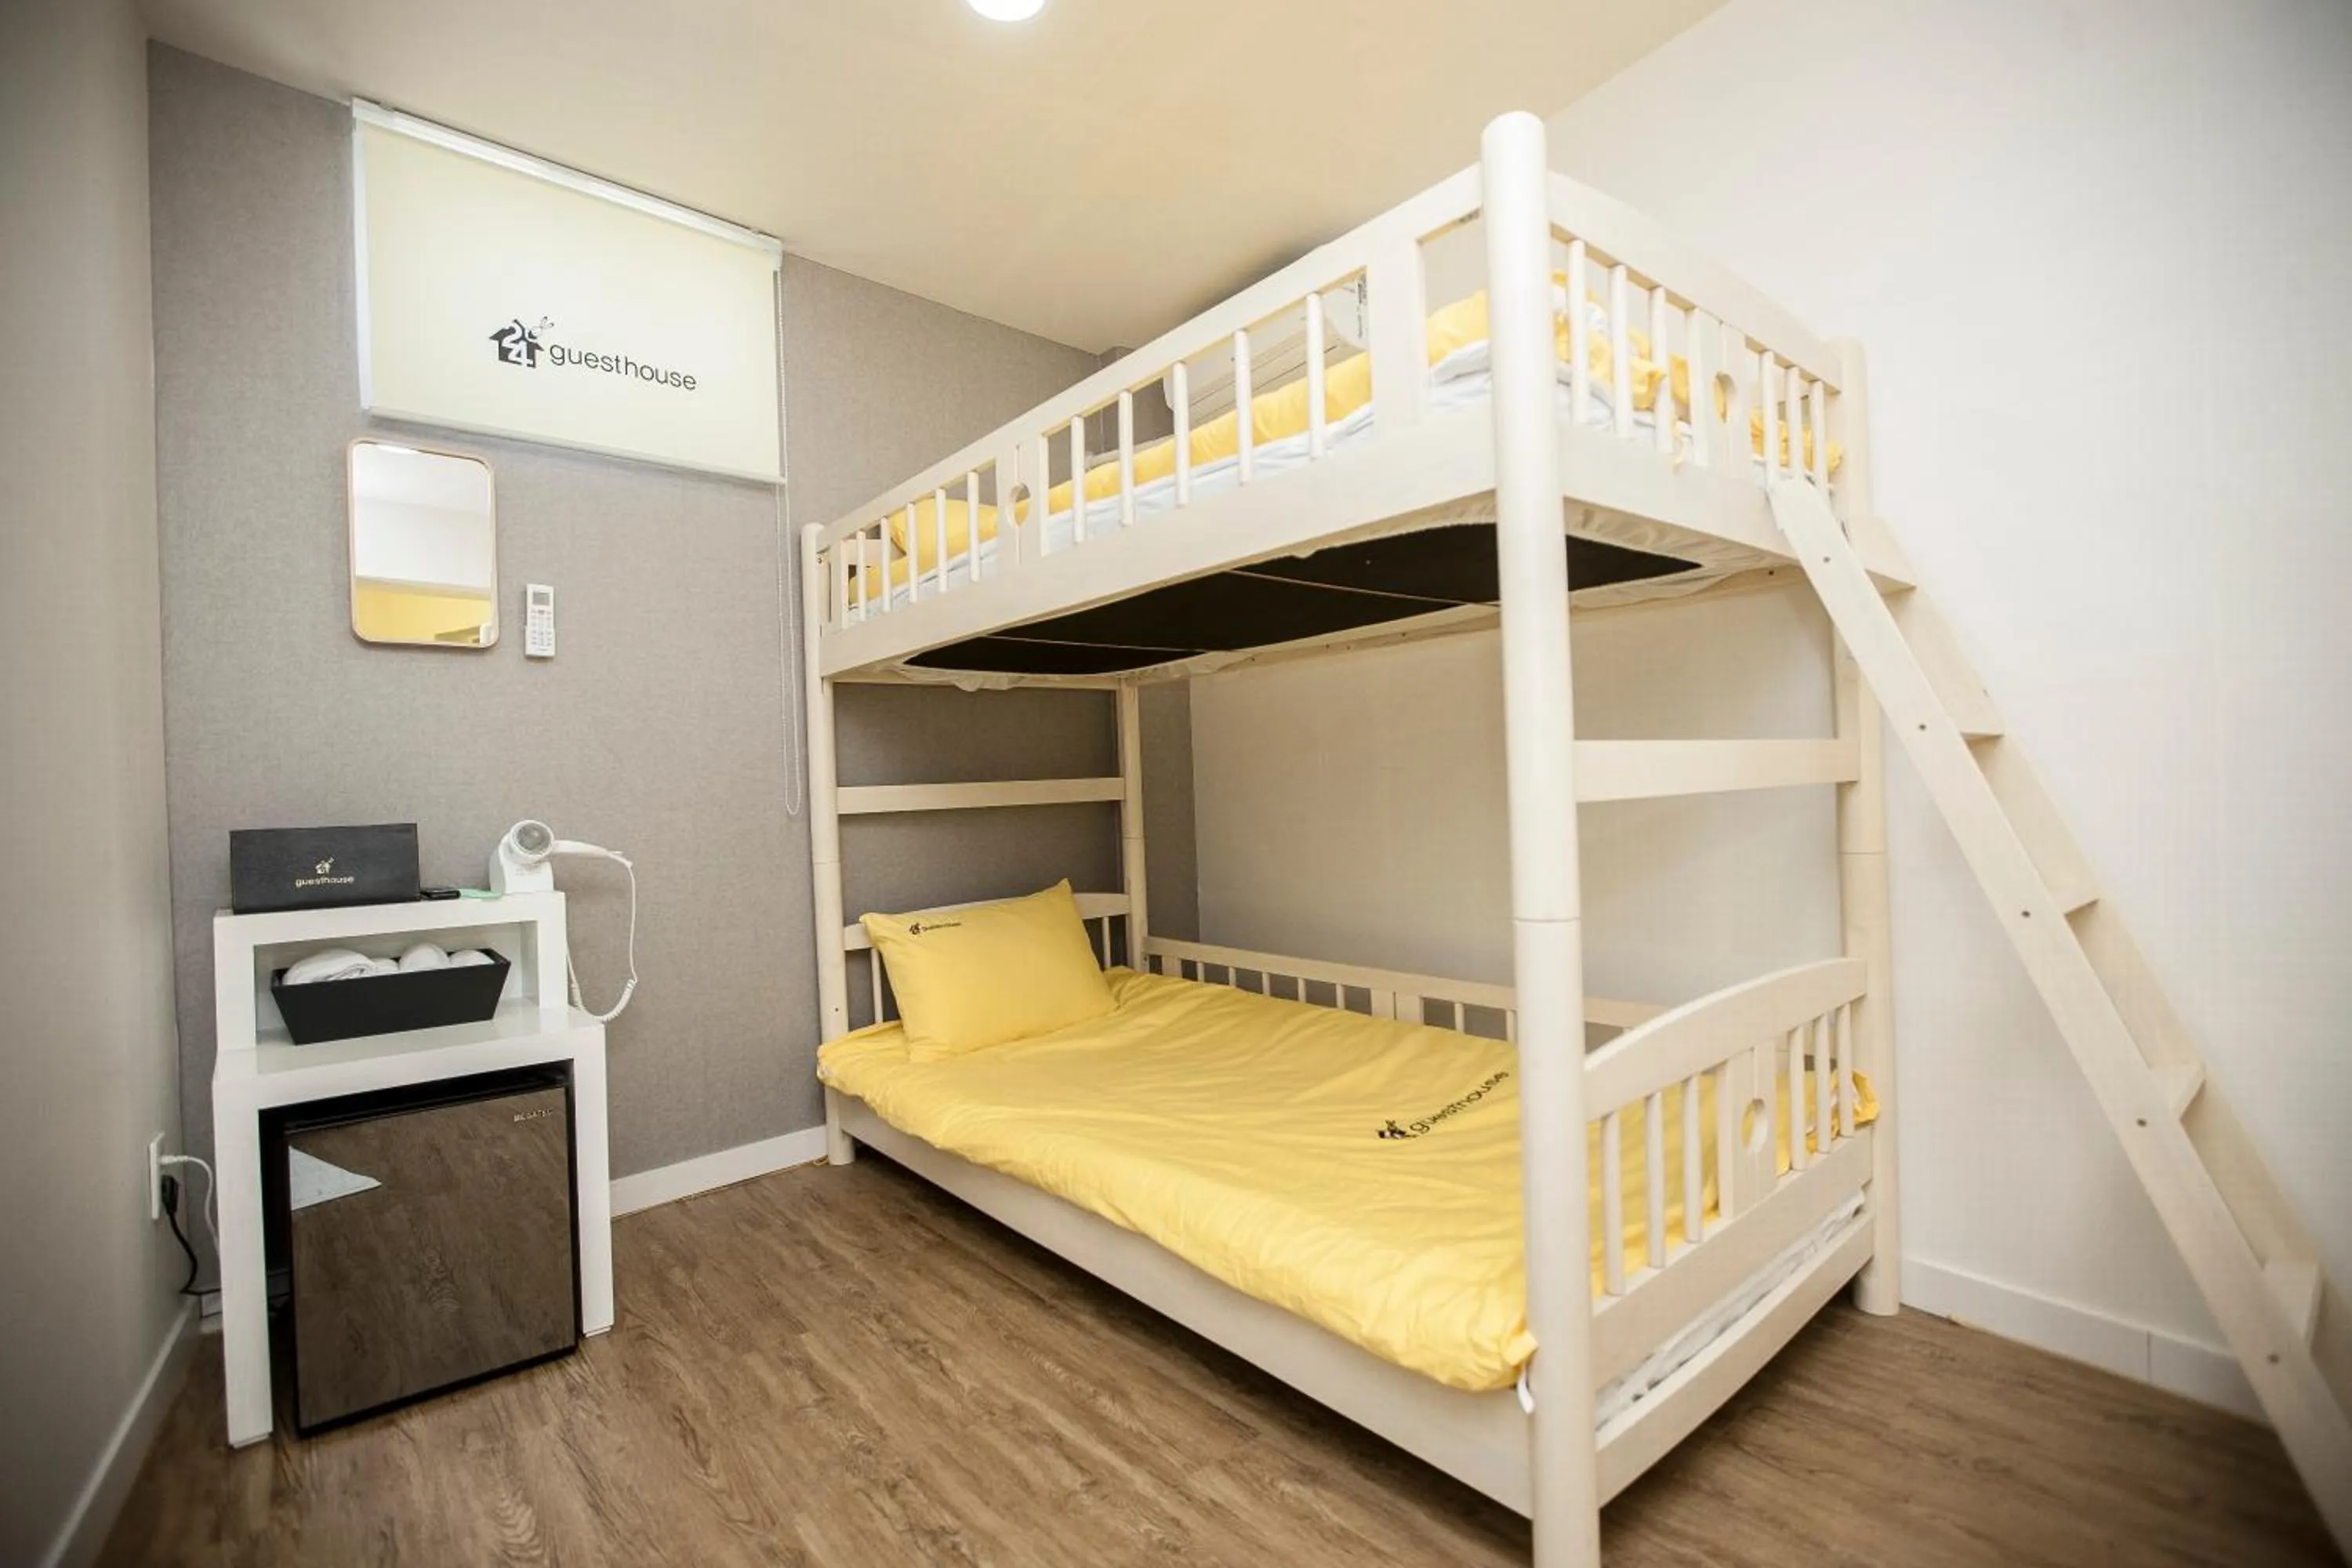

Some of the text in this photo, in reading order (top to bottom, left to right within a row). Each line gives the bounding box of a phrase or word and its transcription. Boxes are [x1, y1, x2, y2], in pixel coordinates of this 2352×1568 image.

[550, 344, 697, 390] guesthouse
[296, 876, 354, 888] guesthouse
[1410, 1071, 1509, 1134] guesthouse
